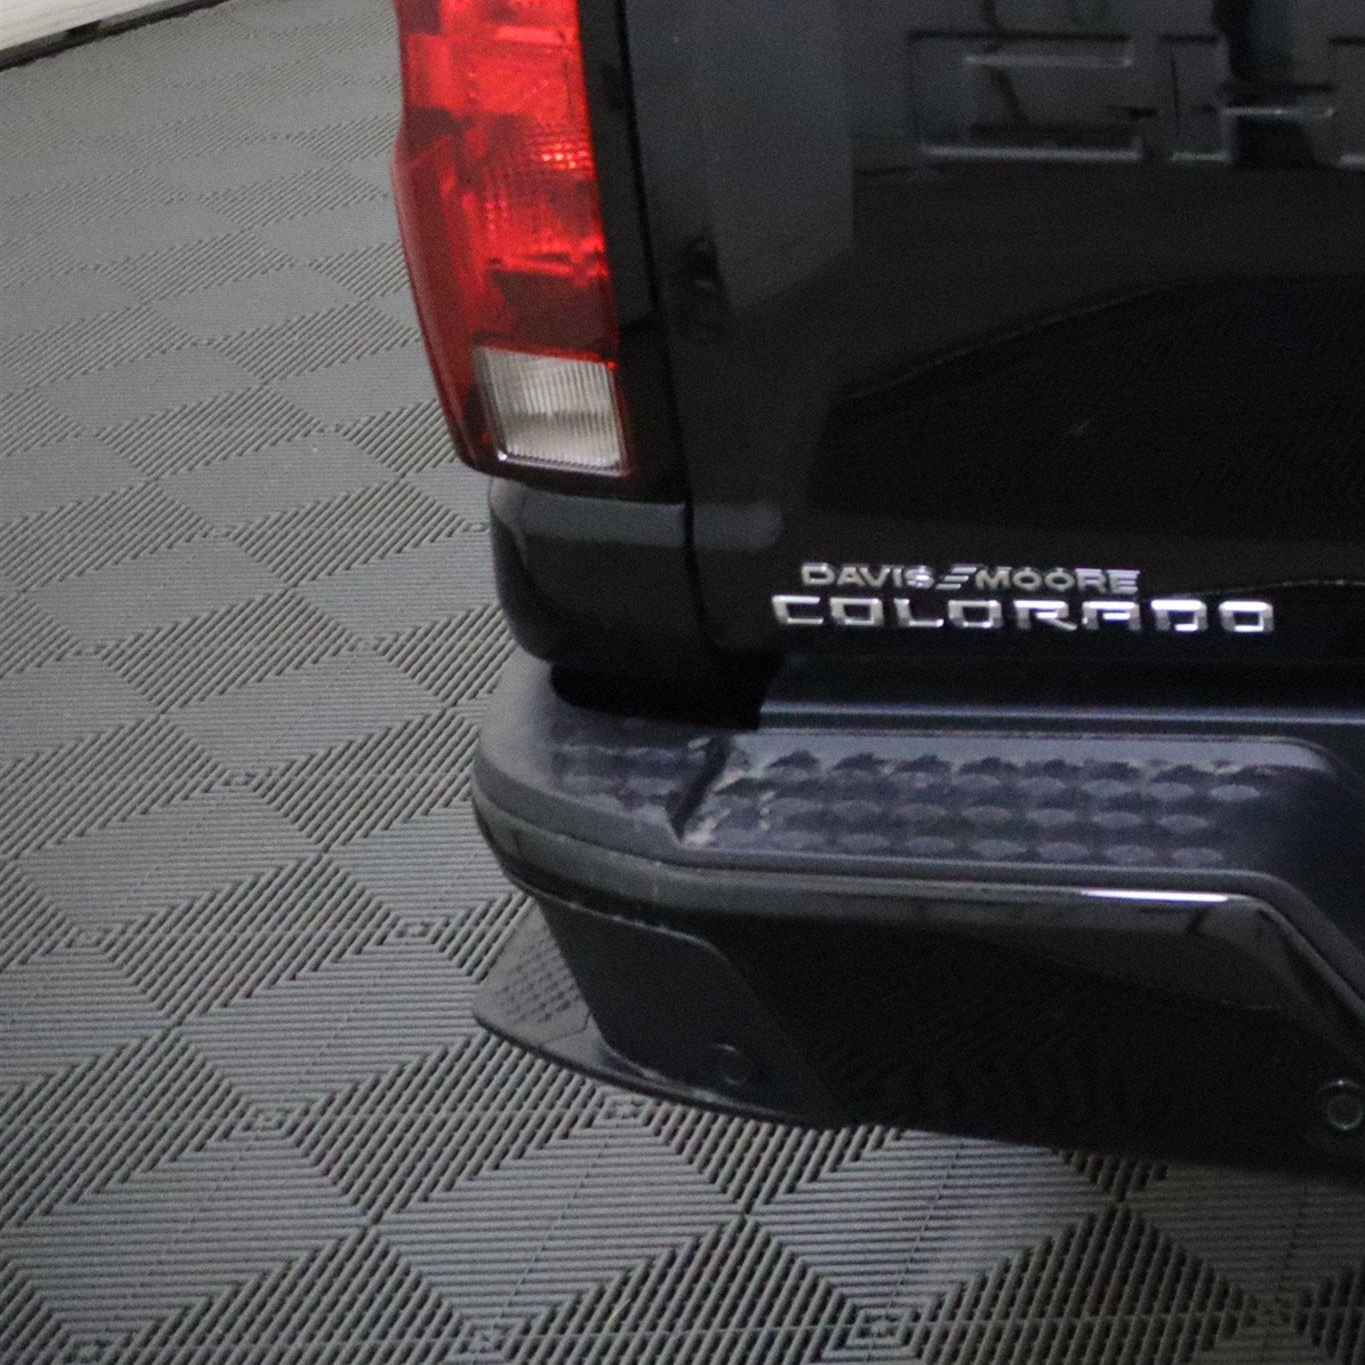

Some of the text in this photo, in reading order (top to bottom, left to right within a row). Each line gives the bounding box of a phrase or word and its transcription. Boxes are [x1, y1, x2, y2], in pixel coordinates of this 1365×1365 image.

[801, 563, 1141, 595] DAVIS MOORE
[771, 594, 1275, 633] COLORADO
